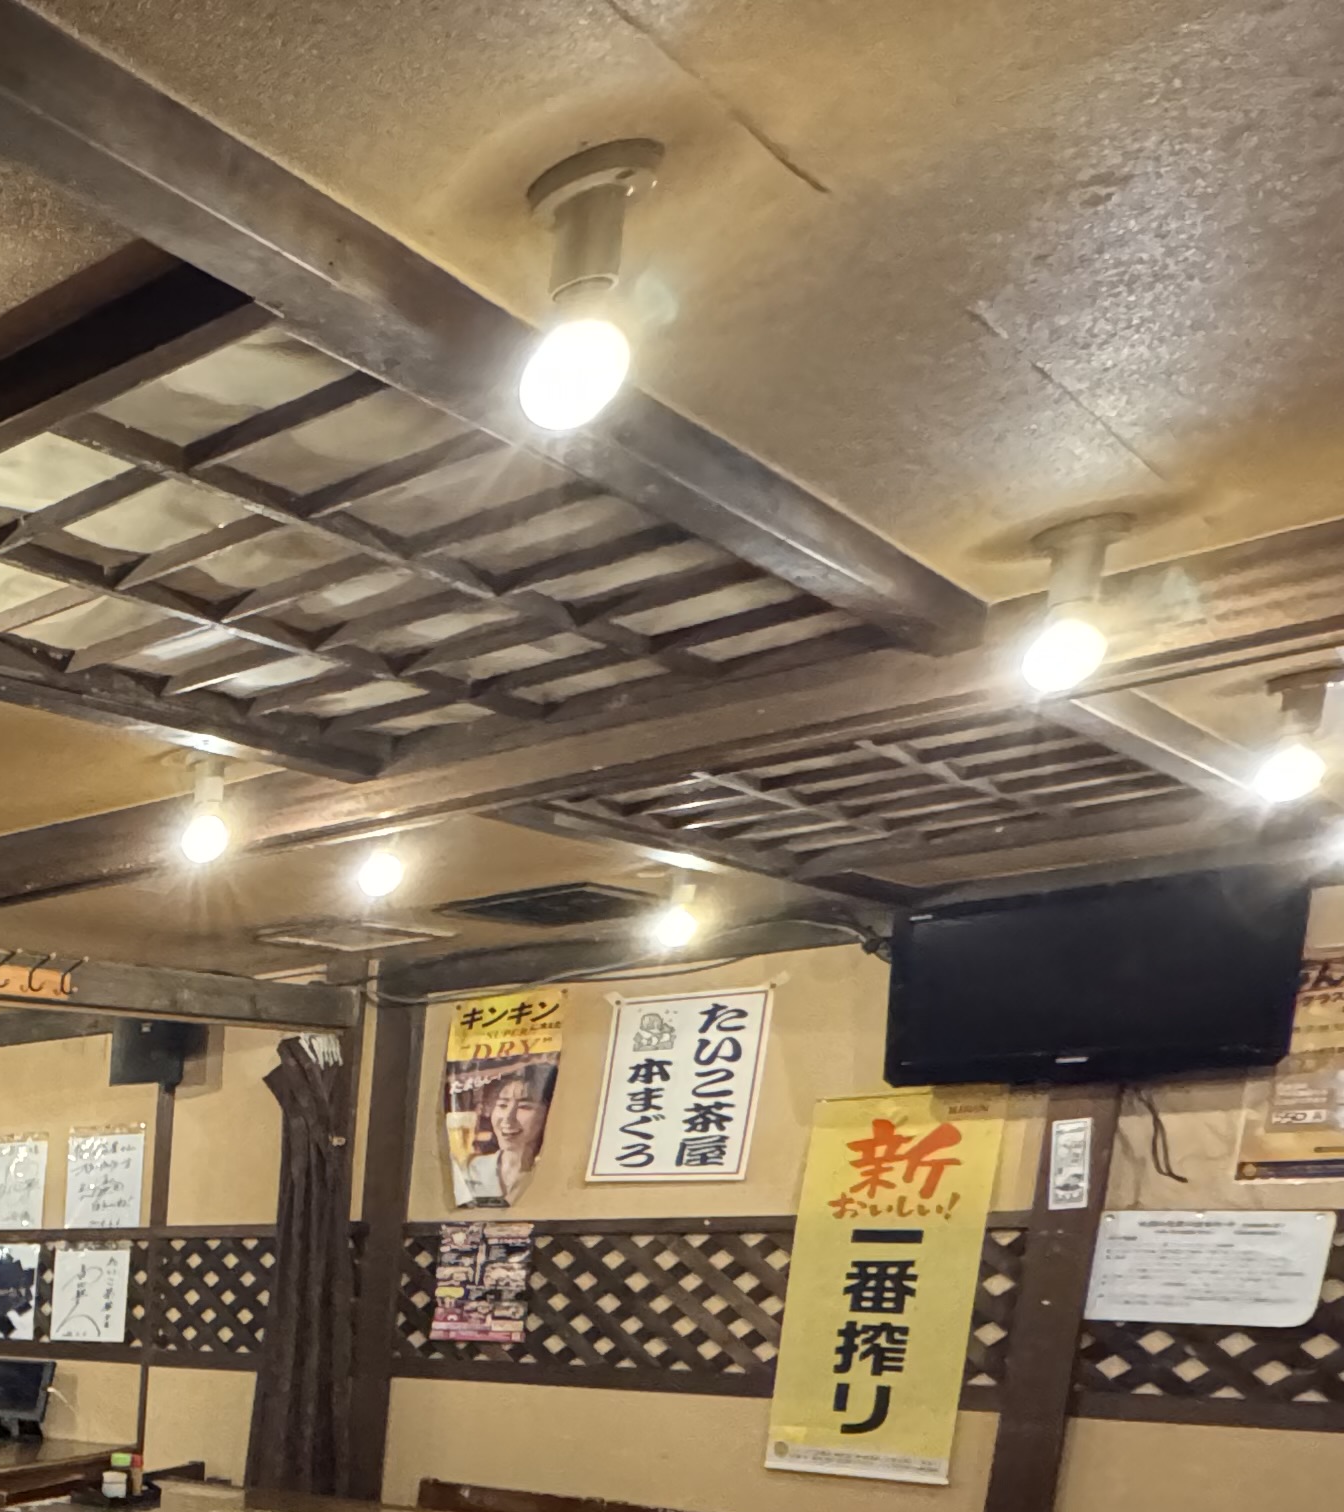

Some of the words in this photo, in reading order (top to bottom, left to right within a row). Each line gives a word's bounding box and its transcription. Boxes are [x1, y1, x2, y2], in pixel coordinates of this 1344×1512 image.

[460, 1002, 560, 1030] キンキン
[615, 1058, 673, 1168] 本まぐろ
[675, 1003, 748, 1167] たいこ茶屋
[846, 1118, 962, 1199] 新
[832, 1228, 925, 1435] 一番搾り
